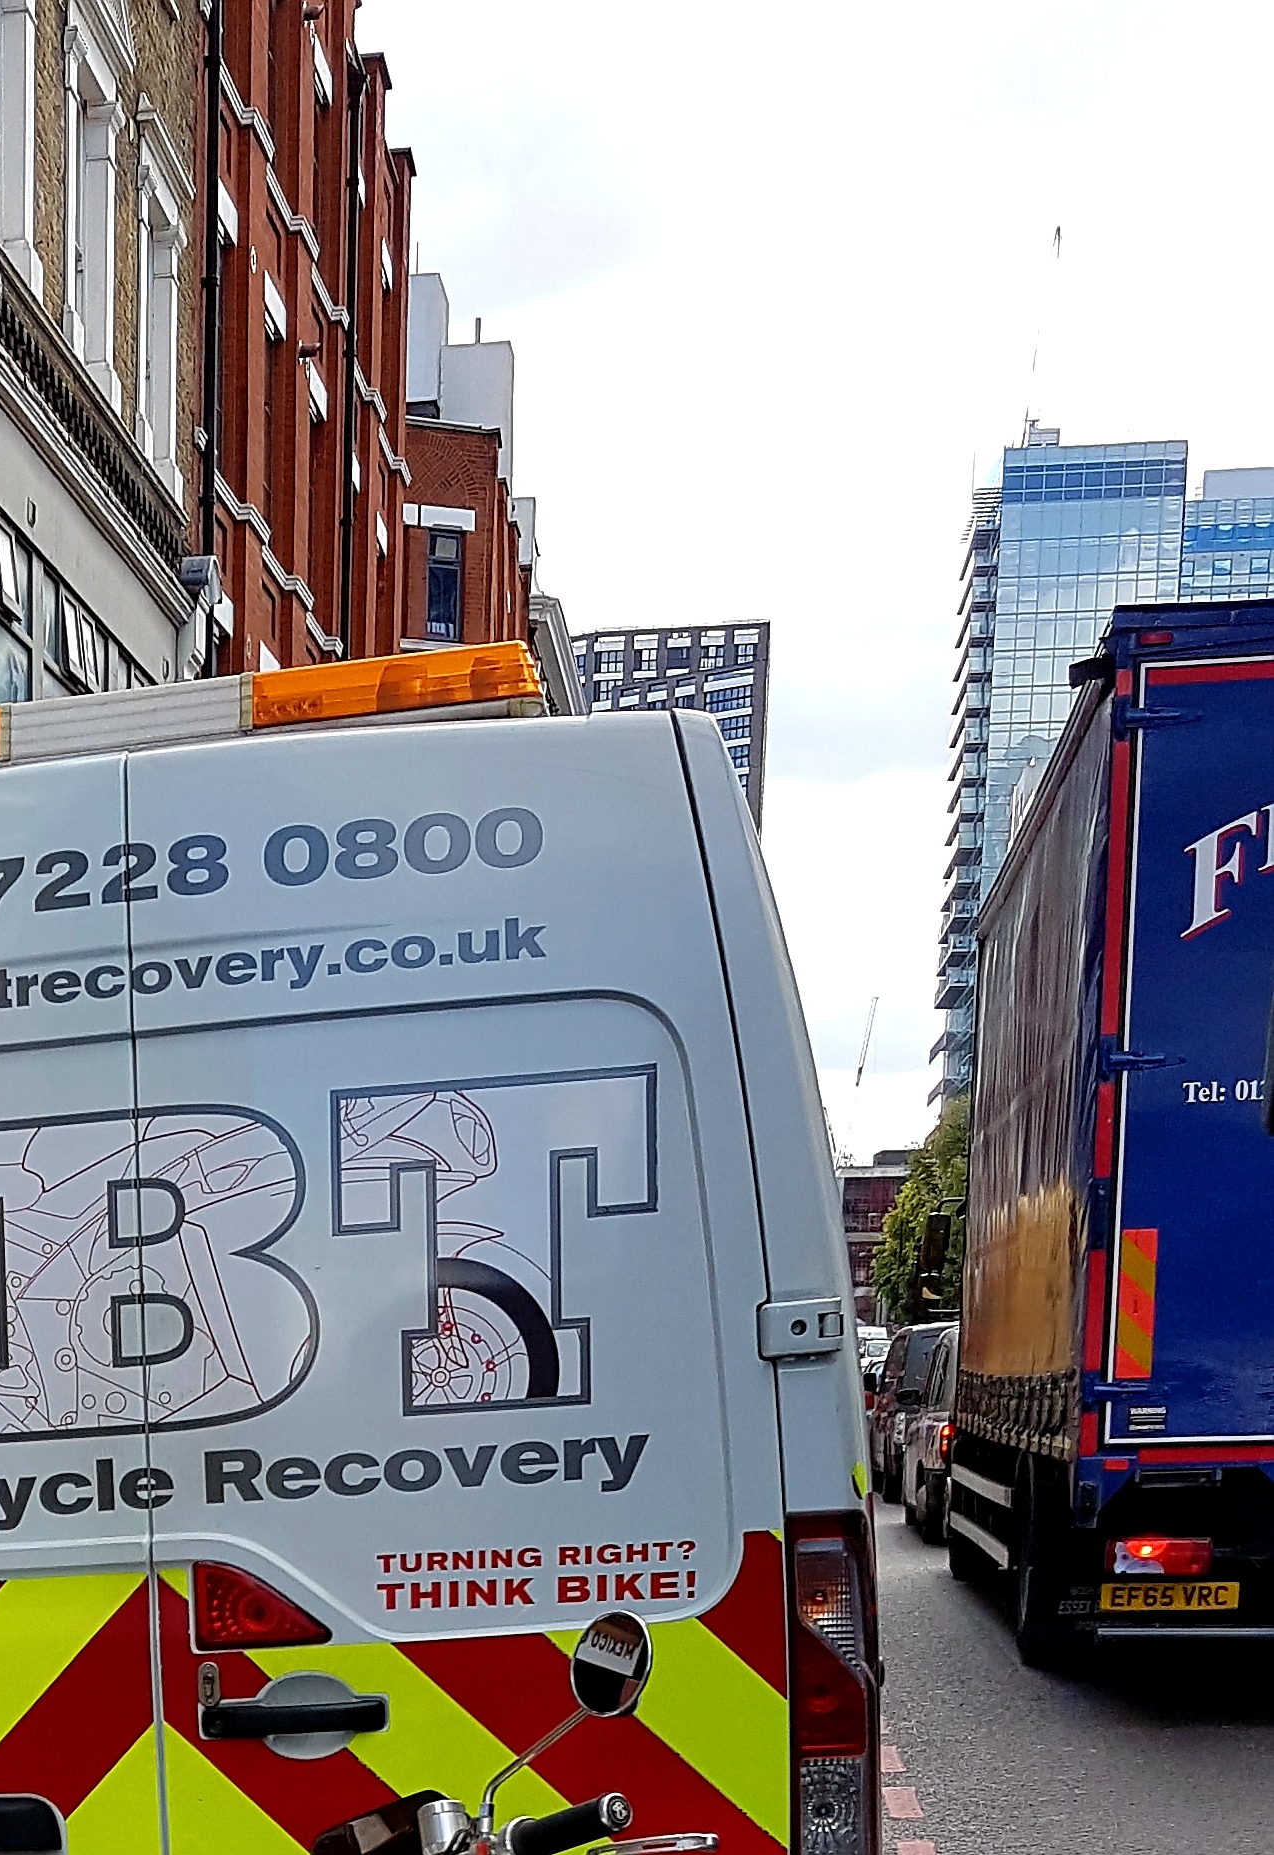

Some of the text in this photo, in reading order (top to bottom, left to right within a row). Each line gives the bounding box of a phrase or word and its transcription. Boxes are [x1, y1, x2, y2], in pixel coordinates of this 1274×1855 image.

[262, 806, 545, 888] 0800
[1182, 1080, 1226, 1104] Tel:
[203, 1431, 651, 1506] Recovery
[376, 1540, 697, 1574] TURNING RIGHT?
[376, 1570, 697, 1611] THINK BIKE!
[1110, 1586, 1175, 1608] EF65
[1182, 1585, 1229, 1608] VRC
